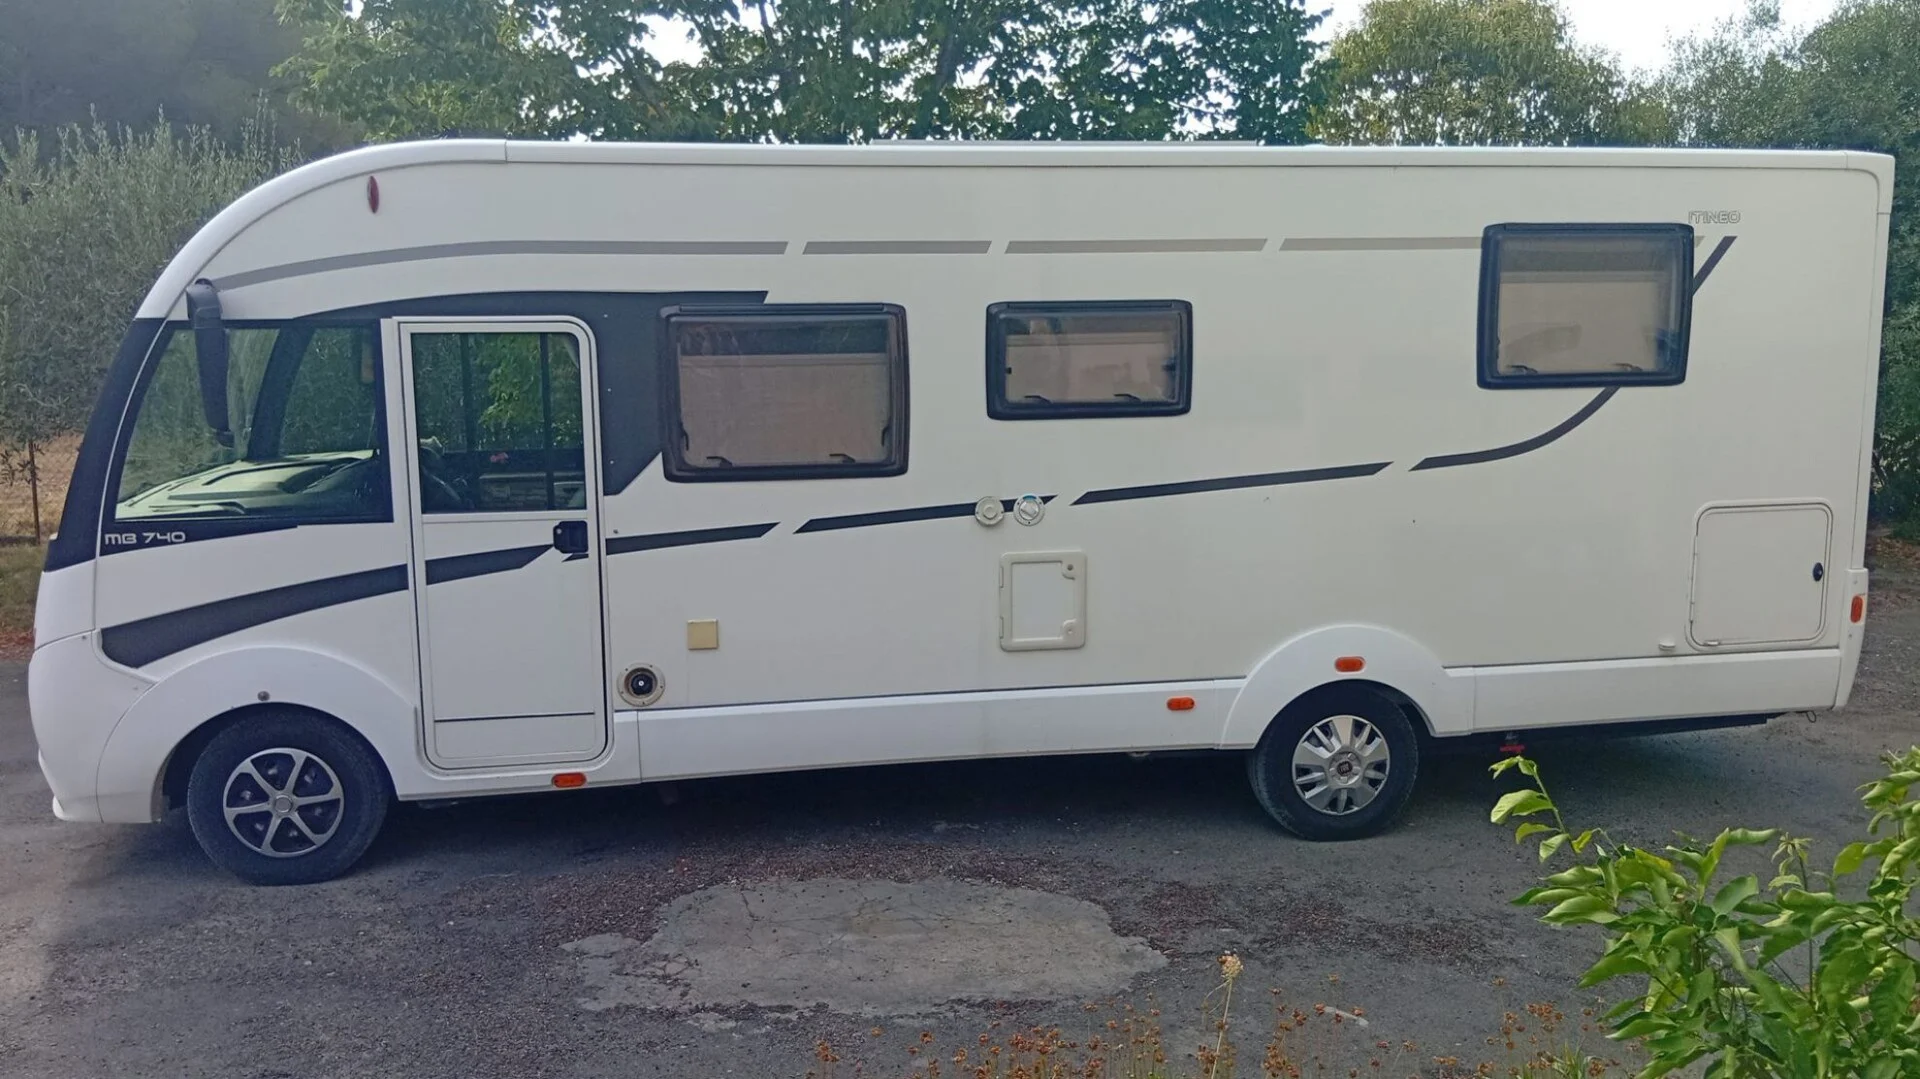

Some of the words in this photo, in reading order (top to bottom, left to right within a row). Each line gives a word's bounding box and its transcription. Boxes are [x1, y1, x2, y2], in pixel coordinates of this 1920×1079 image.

[1688, 210, 1741, 224] ITINEO
[104, 533, 137, 545] MB
[142, 531, 186, 543] 740
